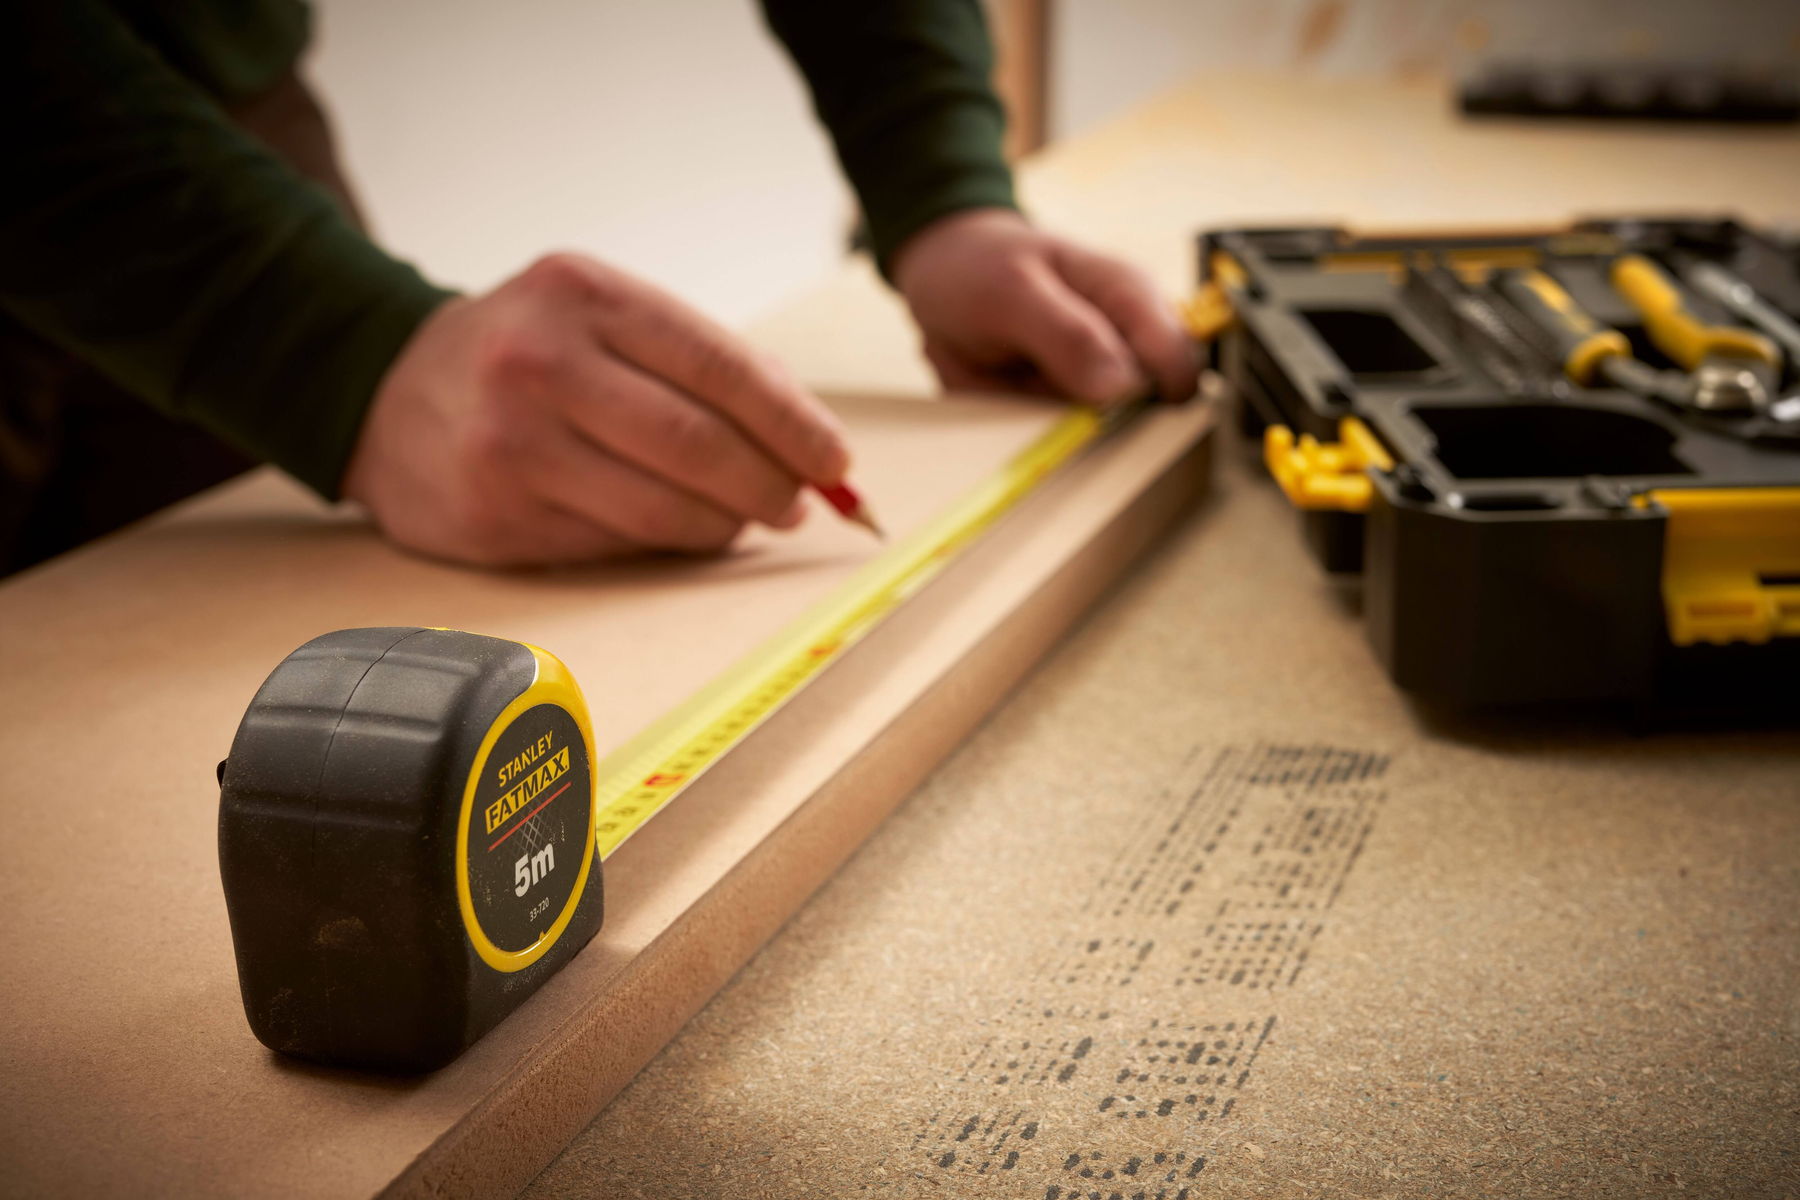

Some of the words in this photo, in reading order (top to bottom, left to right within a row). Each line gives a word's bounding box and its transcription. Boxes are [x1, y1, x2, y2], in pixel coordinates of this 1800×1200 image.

[498, 730, 553, 788] STANLEY
[487, 750, 568, 831] FATMAX
[514, 843, 555, 898] 5m
[529, 897, 550, 922] 33-720
